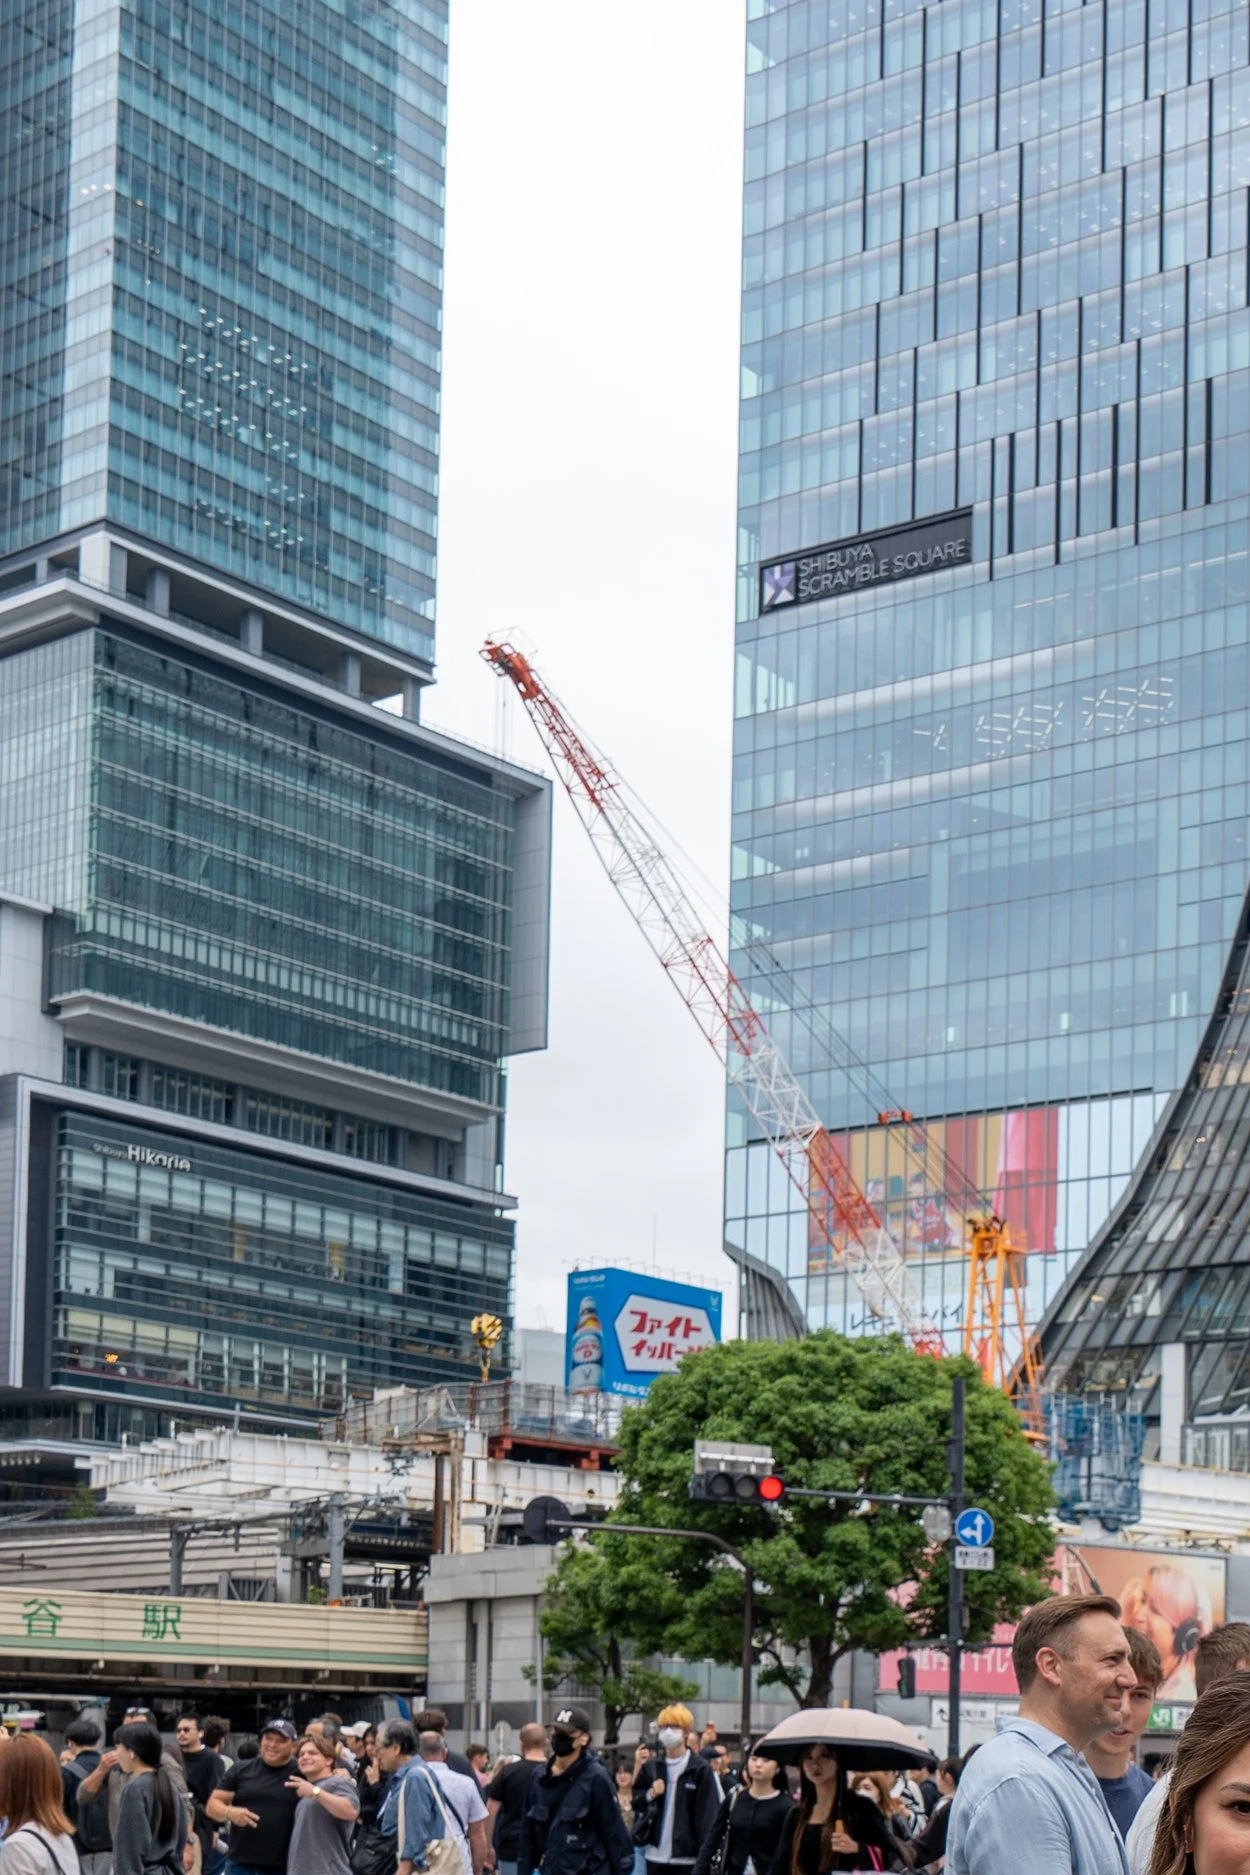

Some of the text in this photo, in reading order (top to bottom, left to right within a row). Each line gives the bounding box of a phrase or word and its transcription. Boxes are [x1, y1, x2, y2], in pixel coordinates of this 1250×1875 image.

[798, 538, 966, 597] SCRAMBLE SQUARE
[799, 543, 874, 577] SHIBUYA
[128, 1144, 191, 1172] Hikarie
[630, 1310, 702, 1338] ファイト
